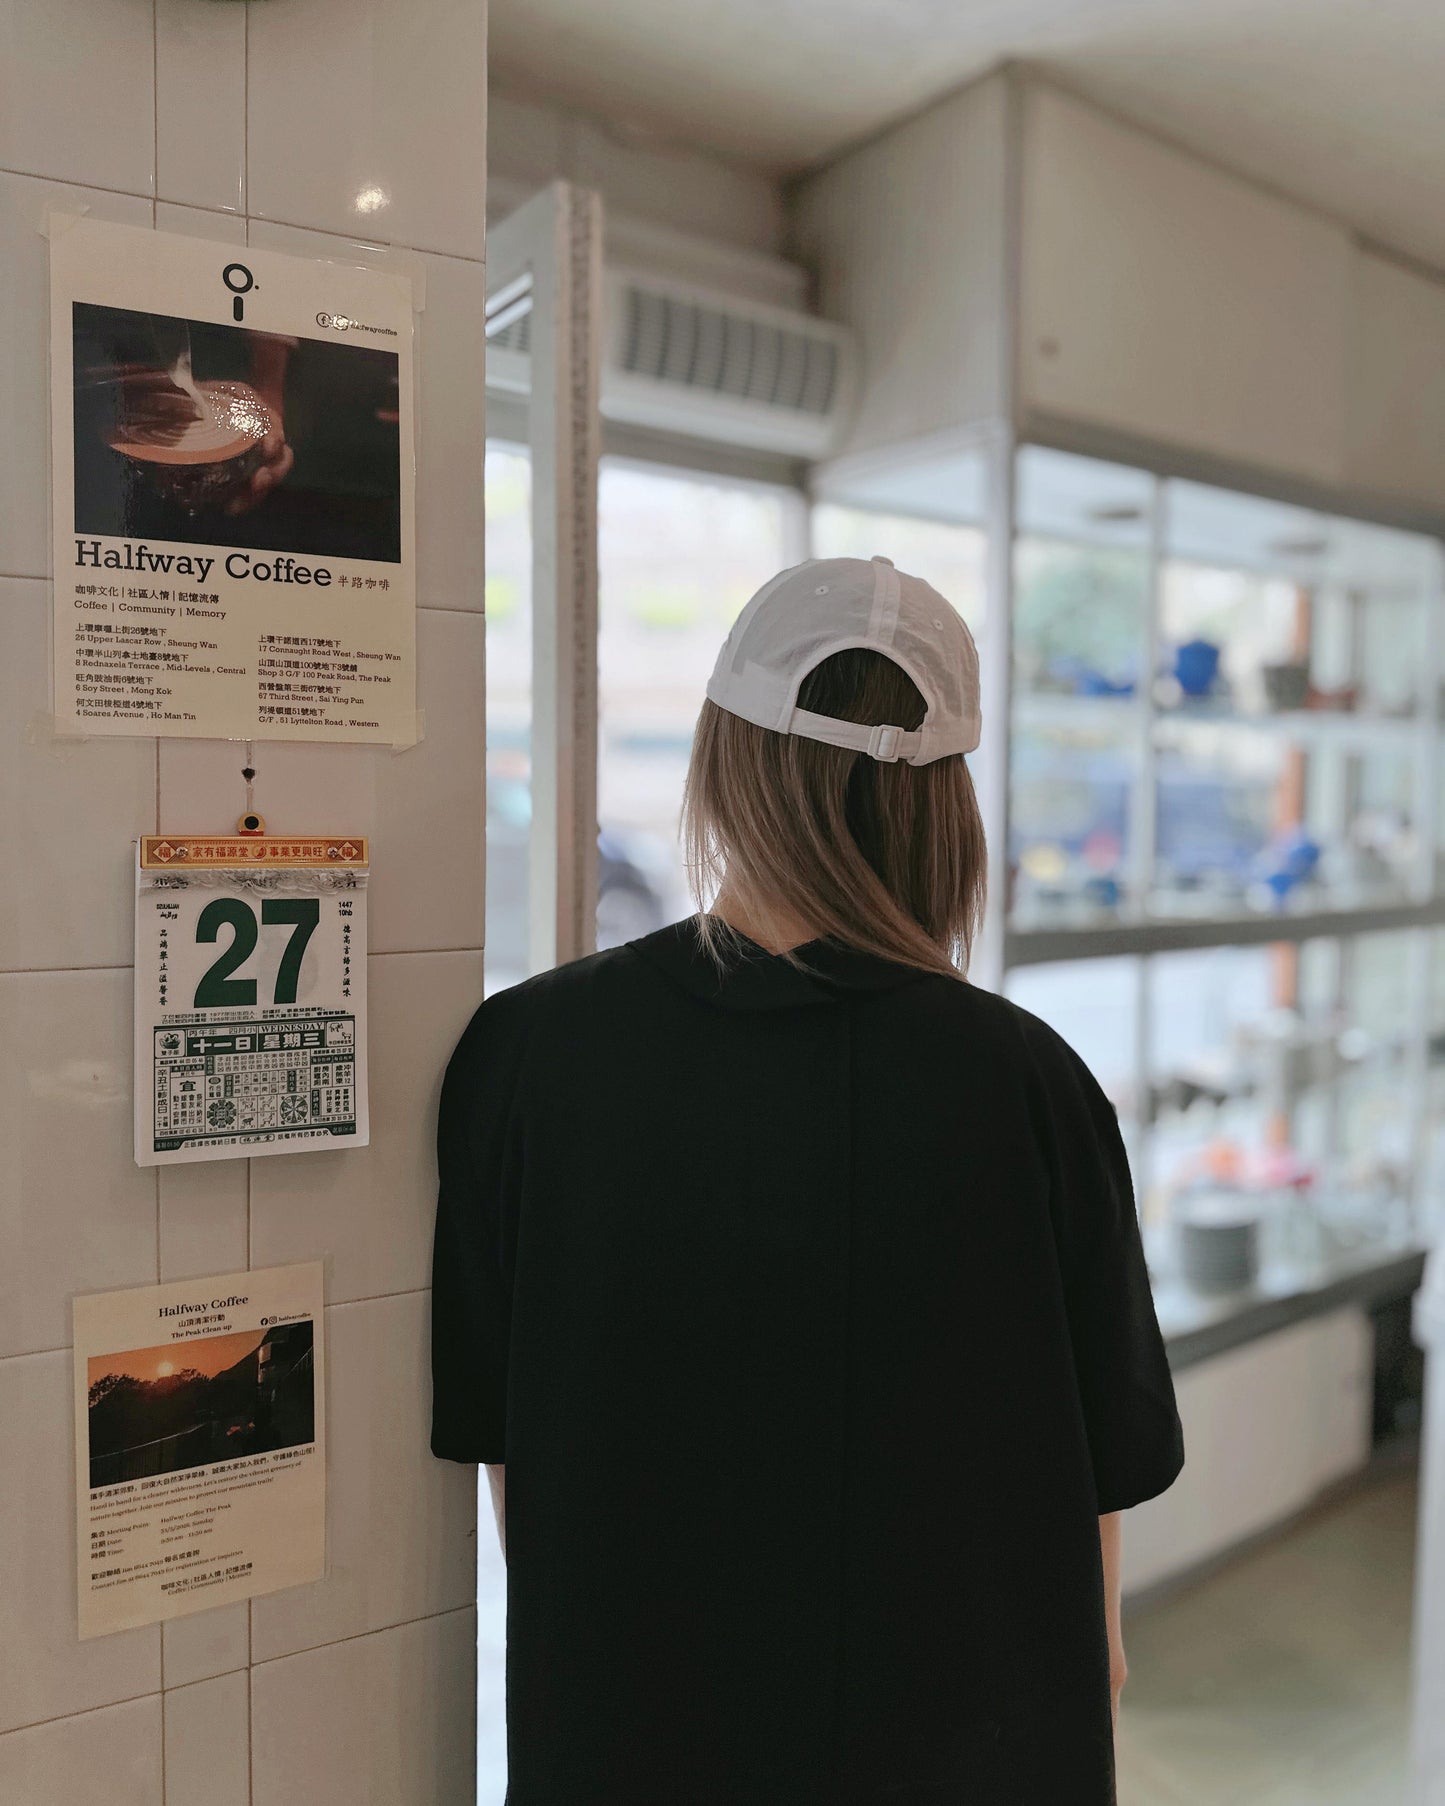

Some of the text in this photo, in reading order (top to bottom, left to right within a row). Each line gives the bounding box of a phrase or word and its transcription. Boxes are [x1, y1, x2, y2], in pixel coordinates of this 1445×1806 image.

[75, 541, 332, 587] Halfway Coffee
[338, 576, 389, 591] 半路咖啡
[74, 601, 226, 620] Coffee Community Memory
[88, 635, 113, 643] Upper
[116, 637, 142, 645] Lascar
[168, 640, 198, 649] Sheung
[200, 641, 217, 649] Wan
[269, 646, 310, 656] Connaught
[357, 652, 383, 661] Sheung
[83, 660, 126, 668] Rednaxela
[167, 664, 210, 672] Mid-Levels
[217, 666, 246, 675] Central
[258, 669, 277, 677] Shop
[83, 685, 98, 693] Soy
[100, 685, 124, 693] Street
[131, 687, 154, 695] Mong
[291, 717, 323, 725] Lyttelton
[193, 847, 322, 858] 家有福源堂 事業更興旺
[194, 898, 320, 1008] 27
[261, 1023, 322, 1033] WEDNESDAY
[193, 1037, 250, 1053] 十一日
[263, 1033, 320, 1049] 星期三
[180, 1081, 196, 1092] 宜
[159, 1296, 248, 1317] Halfway Coffee
